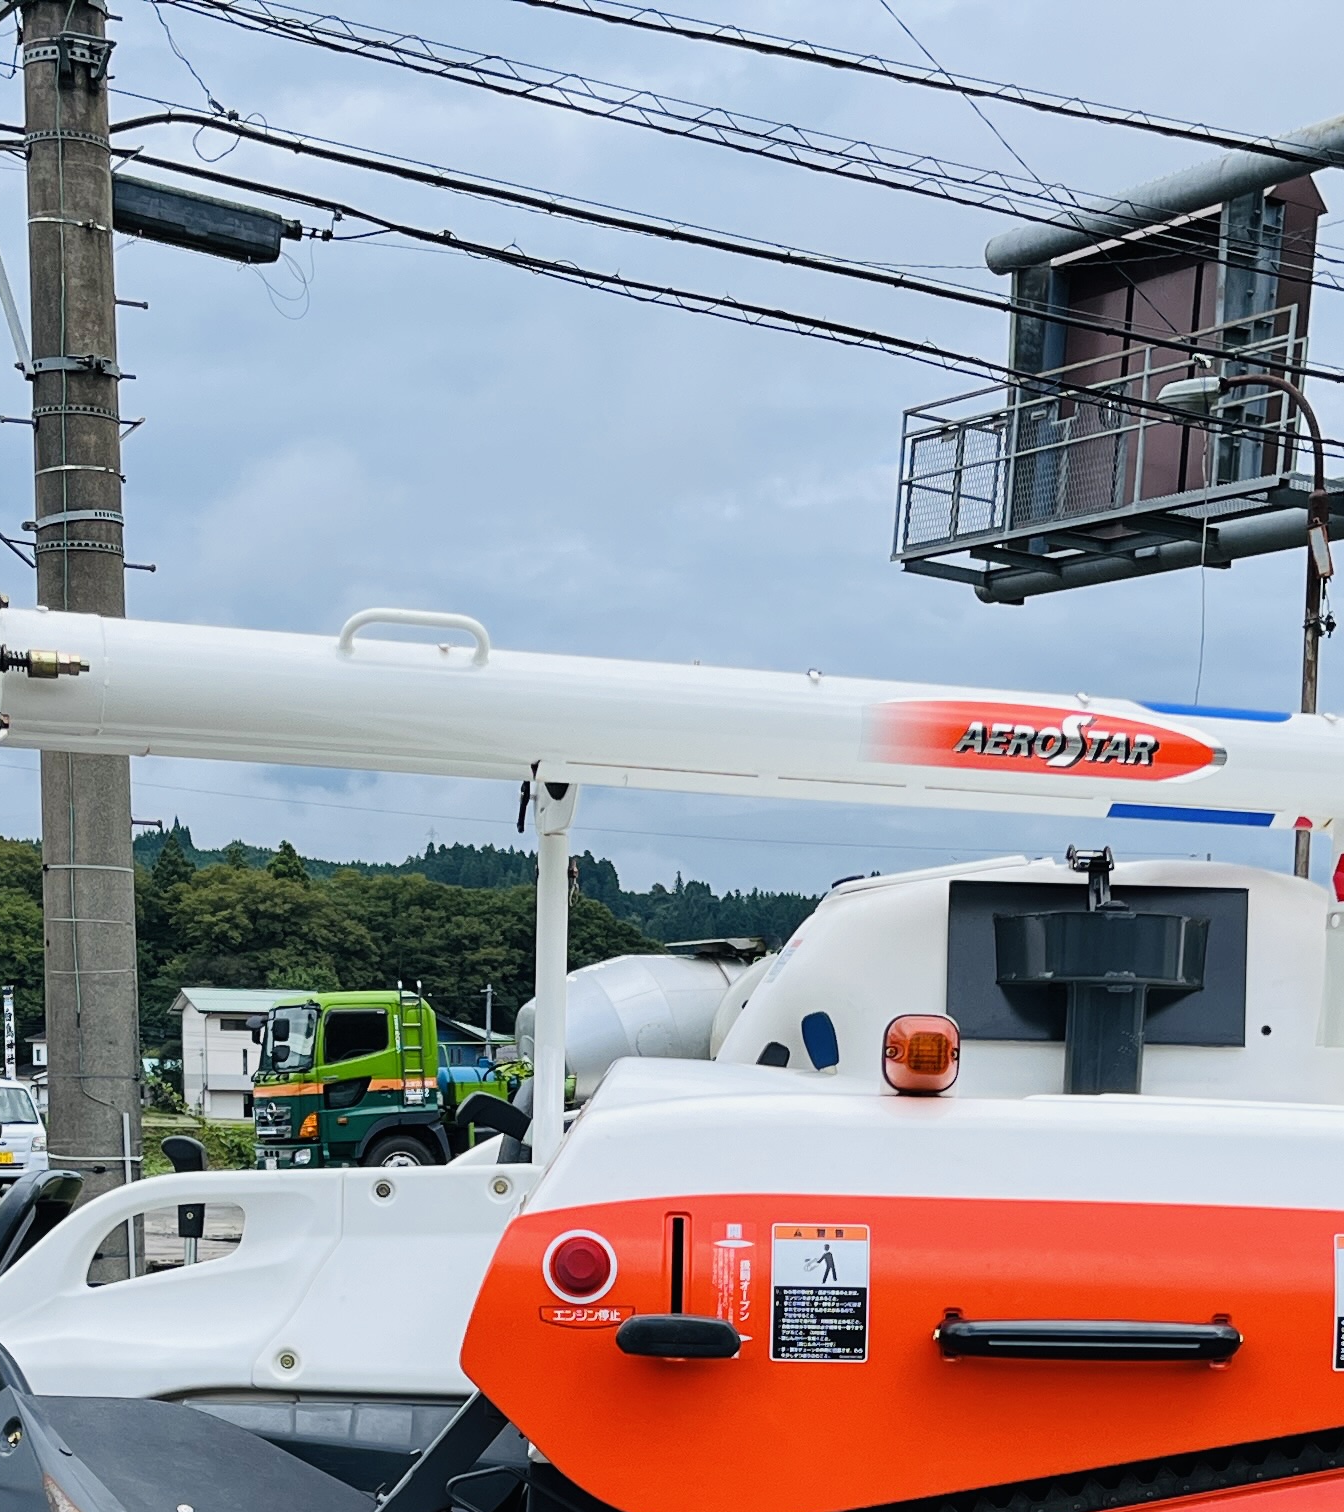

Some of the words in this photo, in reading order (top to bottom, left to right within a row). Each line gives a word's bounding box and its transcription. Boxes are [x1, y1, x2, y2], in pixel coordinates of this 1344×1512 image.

[953, 715, 1160, 768] AEROSTAR
[552, 1309, 622, 1322] エンジン停止
